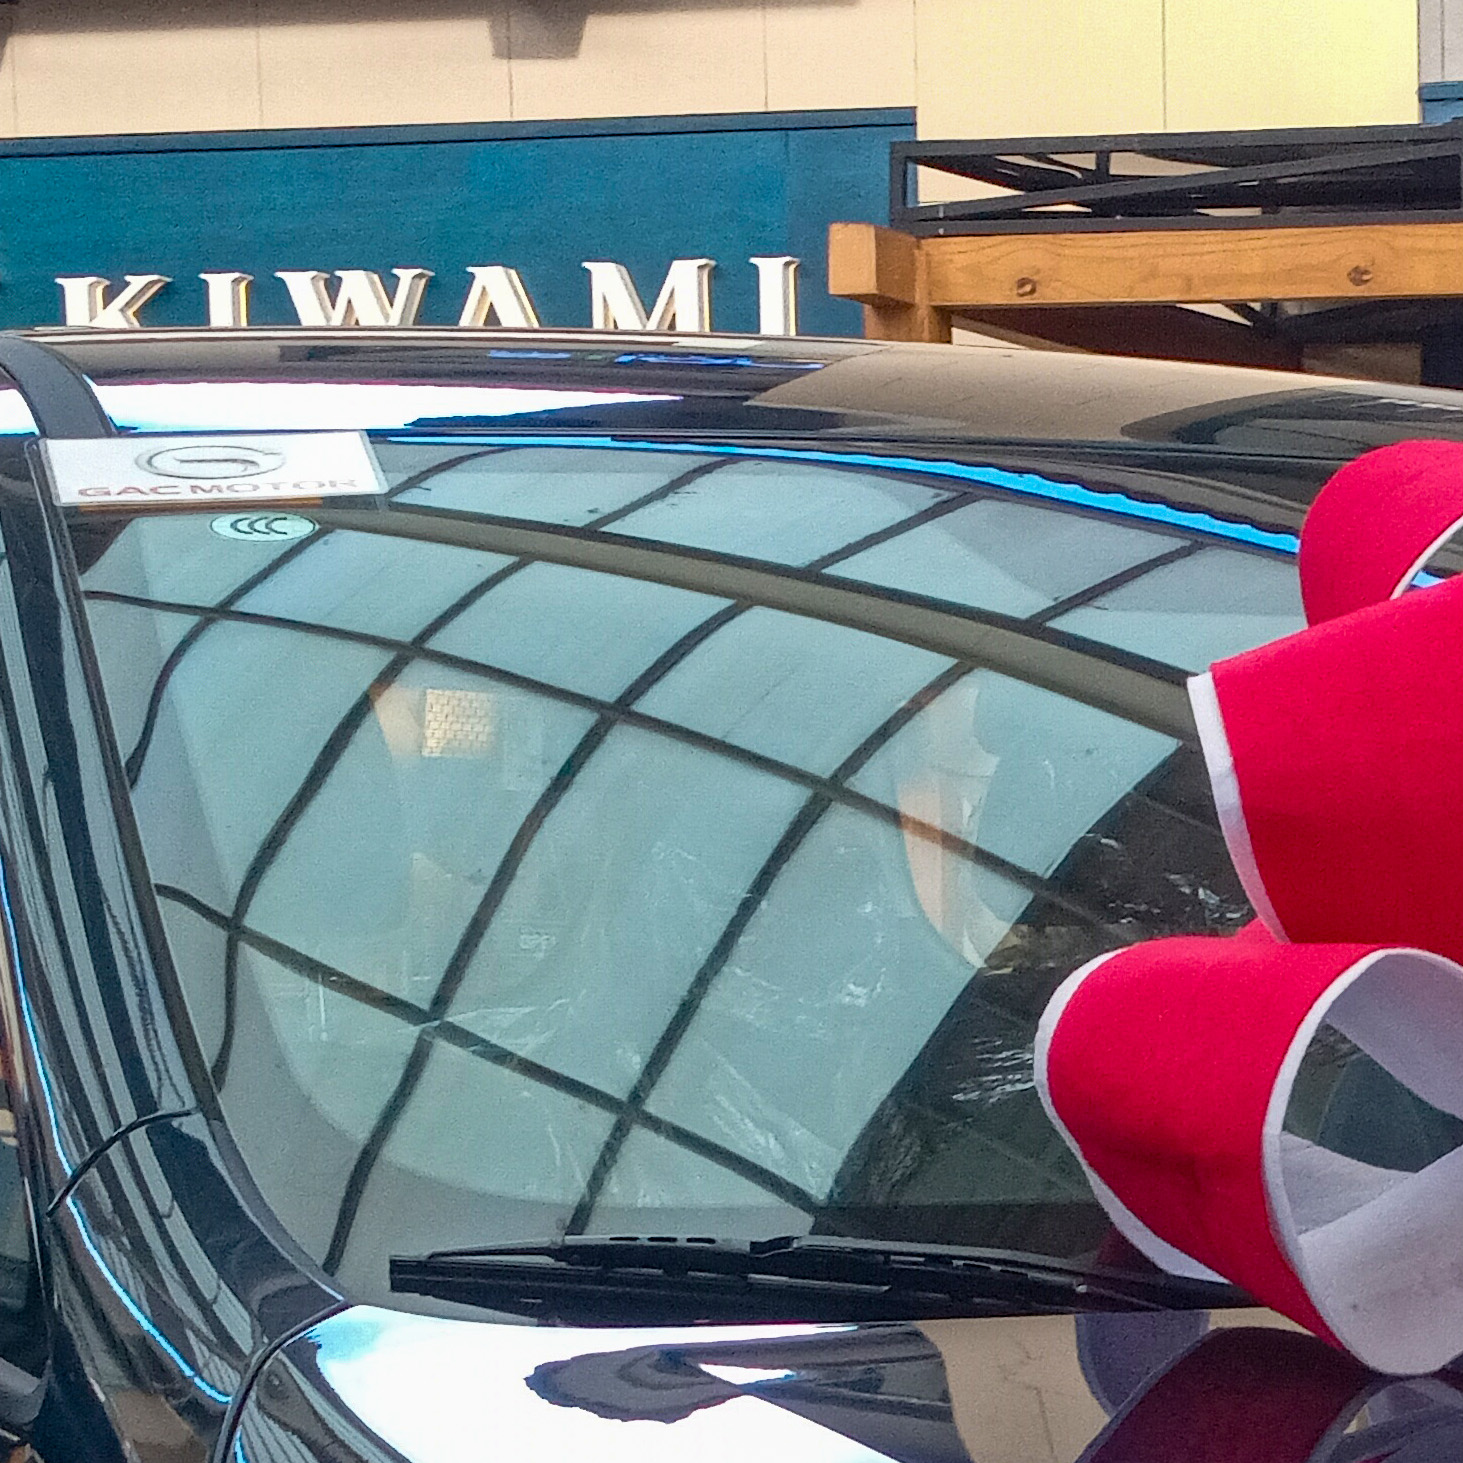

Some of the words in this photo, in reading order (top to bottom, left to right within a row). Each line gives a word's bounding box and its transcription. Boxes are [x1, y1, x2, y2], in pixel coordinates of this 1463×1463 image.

[53, 256, 800, 336] KIWAMI
[78, 484, 182, 497] GAC
[188, 479, 359, 495] MOTOR
